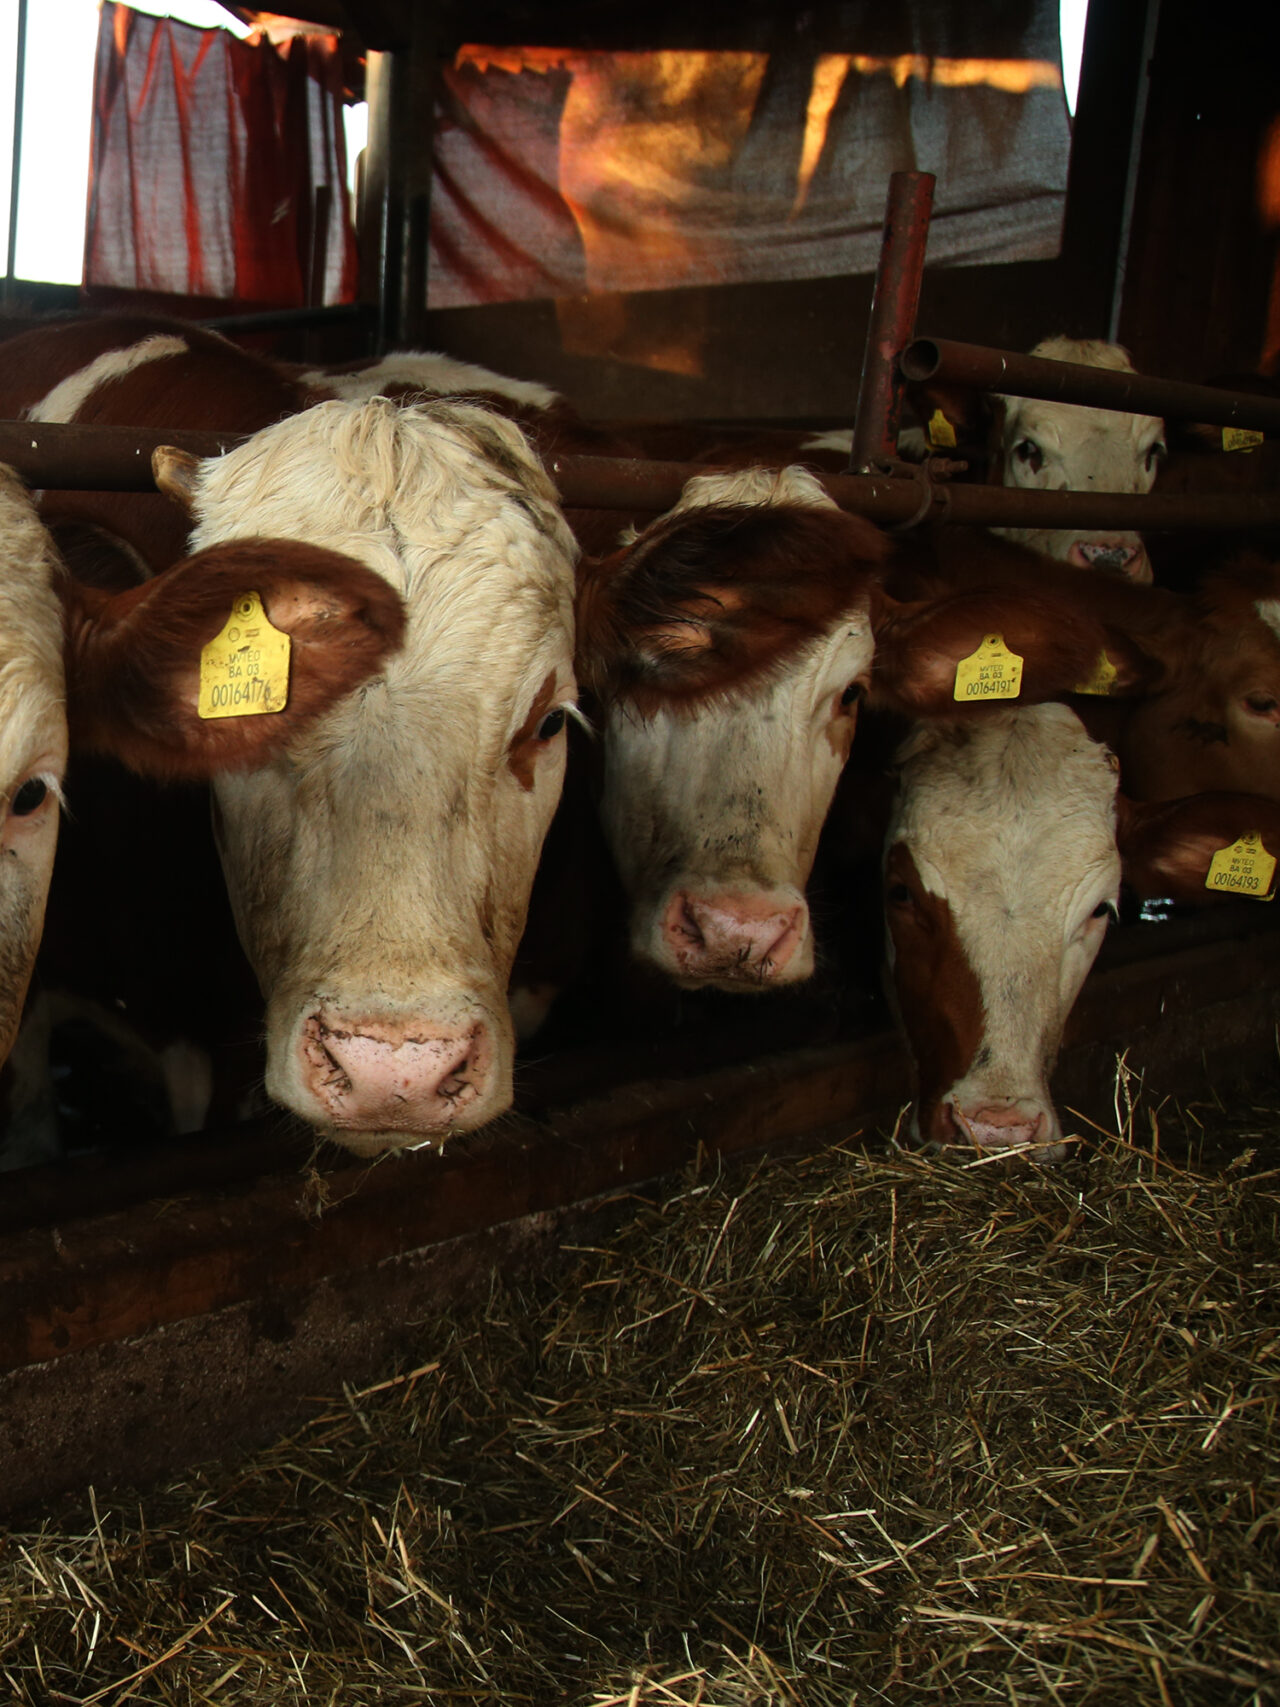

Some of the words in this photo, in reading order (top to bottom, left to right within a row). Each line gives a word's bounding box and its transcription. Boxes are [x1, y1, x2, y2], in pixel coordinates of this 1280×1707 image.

[229, 666, 242, 678] BA
[247, 664, 259, 676] 03
[980, 672, 990, 680] BA
[993, 671, 1003, 679] 03
[212, 680, 271, 707] 00164176
[966, 680, 1011, 695] 00164191
[1214, 872, 1259, 889] 00164193
